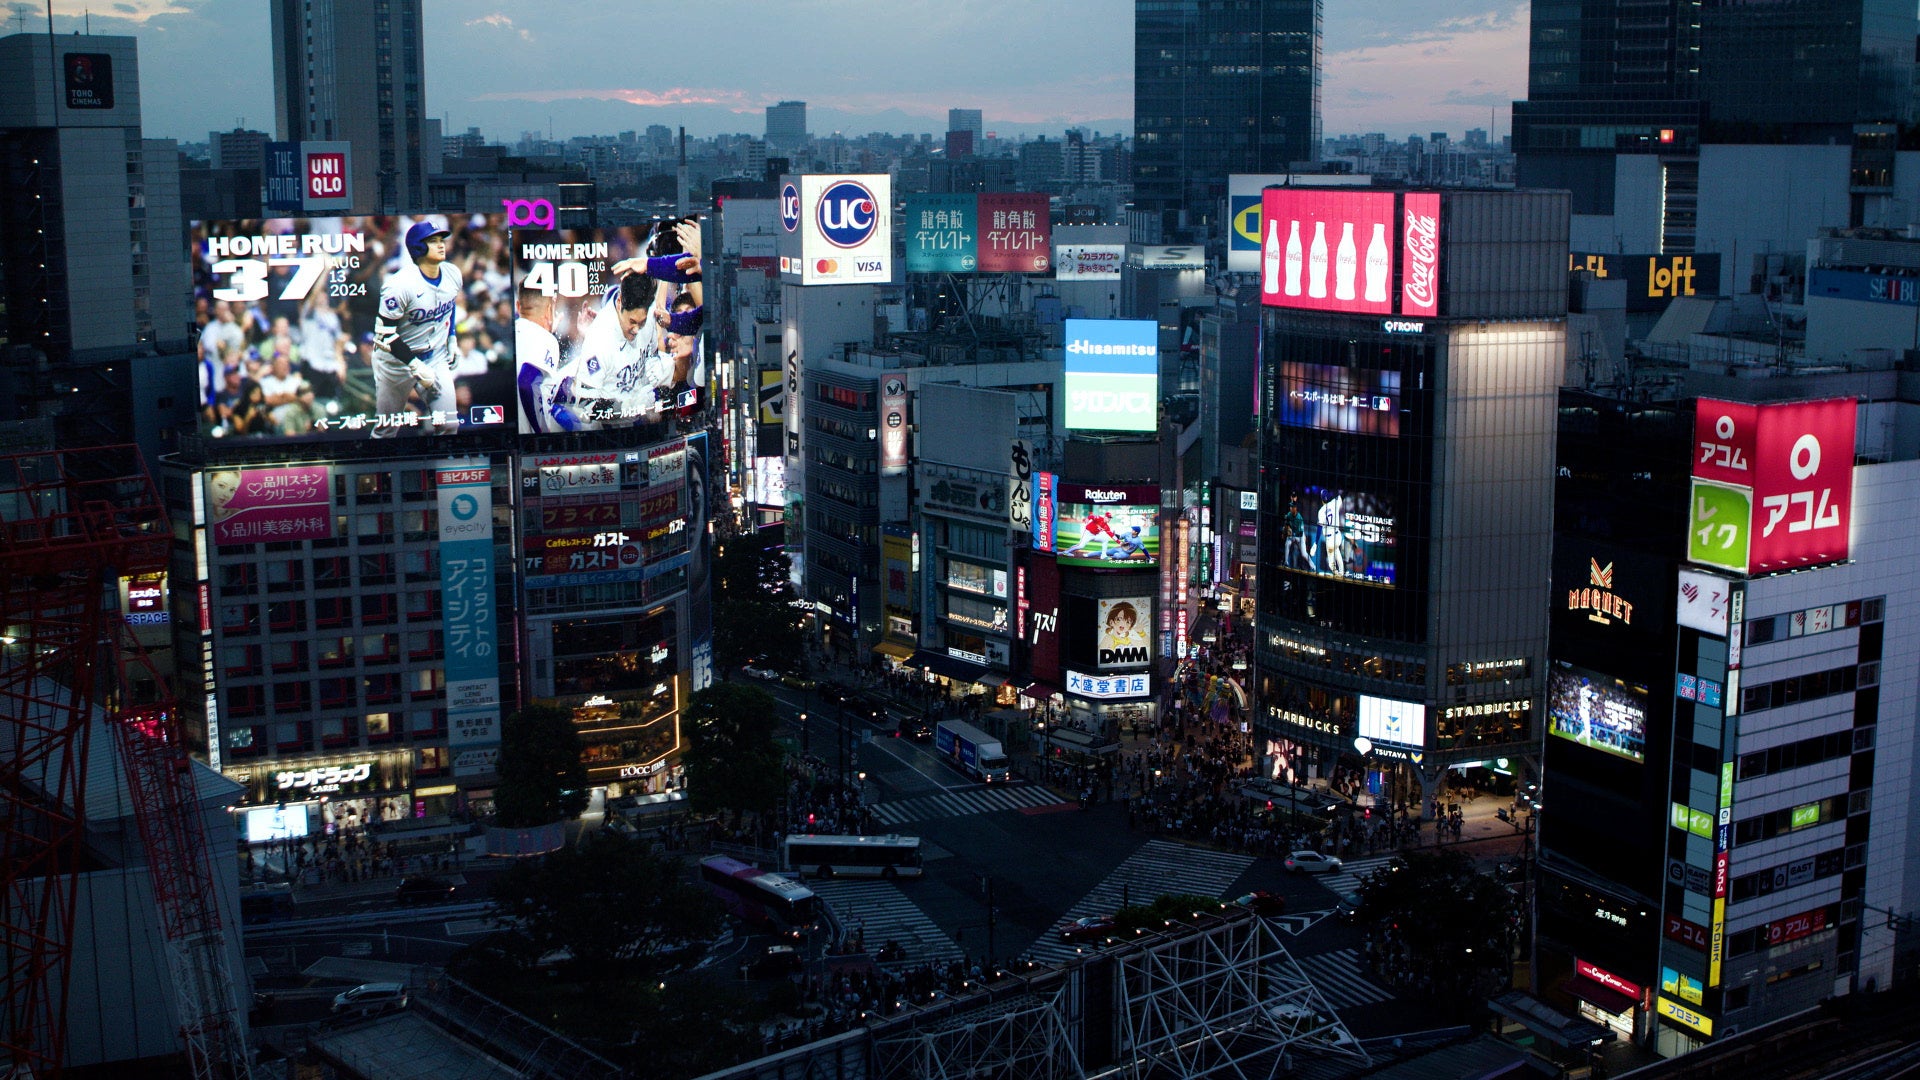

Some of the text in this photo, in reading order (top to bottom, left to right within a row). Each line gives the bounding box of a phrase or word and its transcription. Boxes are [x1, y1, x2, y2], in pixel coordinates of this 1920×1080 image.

[72, 97, 102, 105] CINEMAS
[279, 151, 293, 175] THE
[311, 159, 339, 174] UNI
[269, 177, 300, 201] PRIME
[312, 178, 342, 196] QLO
[503, 199, 554, 230] 109
[784, 196, 800, 220] UC
[823, 198, 875, 230] UC
[921, 210, 963, 230] 龍角散
[993, 210, 1036, 230] 龍角散
[208, 233, 365, 257] HOME RUN
[915, 231, 971, 250] ダイレクト
[987, 231, 1044, 250] ダイレクト
[522, 241, 608, 261] HOME RUN
[330, 255, 360, 269] AUG
[589, 261, 606, 272] AUG
[857, 261, 882, 272] VISA
[1078, 263, 1114, 274] まねきねこ
[212, 257, 327, 302] 37
[330, 269, 347, 283] 13
[523, 261, 590, 298] 40
[589, 272, 600, 284] 23
[330, 283, 367, 297] 2024
[589, 284, 609, 296] 2024
[1067, 340, 1156, 356] Hisamitsu
[1700, 441, 1748, 471] アコム
[263, 474, 323, 488] 品川スキン
[523, 477, 538, 488] 9F
[568, 469, 615, 486] しゃぶ葉
[263, 486, 317, 501] クリニック
[1085, 489, 1127, 502] Rakuten
[1345, 512, 1393, 526] STOLEN BASE
[1762, 488, 1840, 538] アコム
[231, 517, 325, 538] 品川美容外科
[445, 521, 487, 535] eyecity
[668, 517, 686, 535] ガスト
[592, 531, 630, 548] ガスト
[525, 556, 543, 569] 7F
[570, 550, 615, 570] ガスト
[447, 559, 472, 659] アイシティ
[471, 558, 492, 657] コンタクトの
[1568, 587, 1633, 625] MAGNET
[126, 612, 169, 626] ESPACE
[1033, 607, 1058, 645] クスリ
[1099, 647, 1149, 664] DMM
[457, 683, 488, 692] CONTACT
[1070, 676, 1145, 694] 大盛堂書店
[1446, 700, 1531, 719] STARBUCKS
[1604, 699, 1628, 713] HOME
[1269, 706, 1340, 736] STARBUCKS
[1603, 708, 1633, 732] 35
[1374, 748, 1408, 760] TSUTAYA
[275, 763, 372, 790] サンドラッグ
[1677, 808, 1712, 830] レイク
[1794, 809, 1817, 823] レイク
[1790, 862, 1814, 875] EAST
[1670, 919, 1706, 946] アコム
[1785, 918, 1810, 935] アコム
[1712, 922, 1722, 963] プロミス
[1668, 1004, 1702, 1027] プロミス
